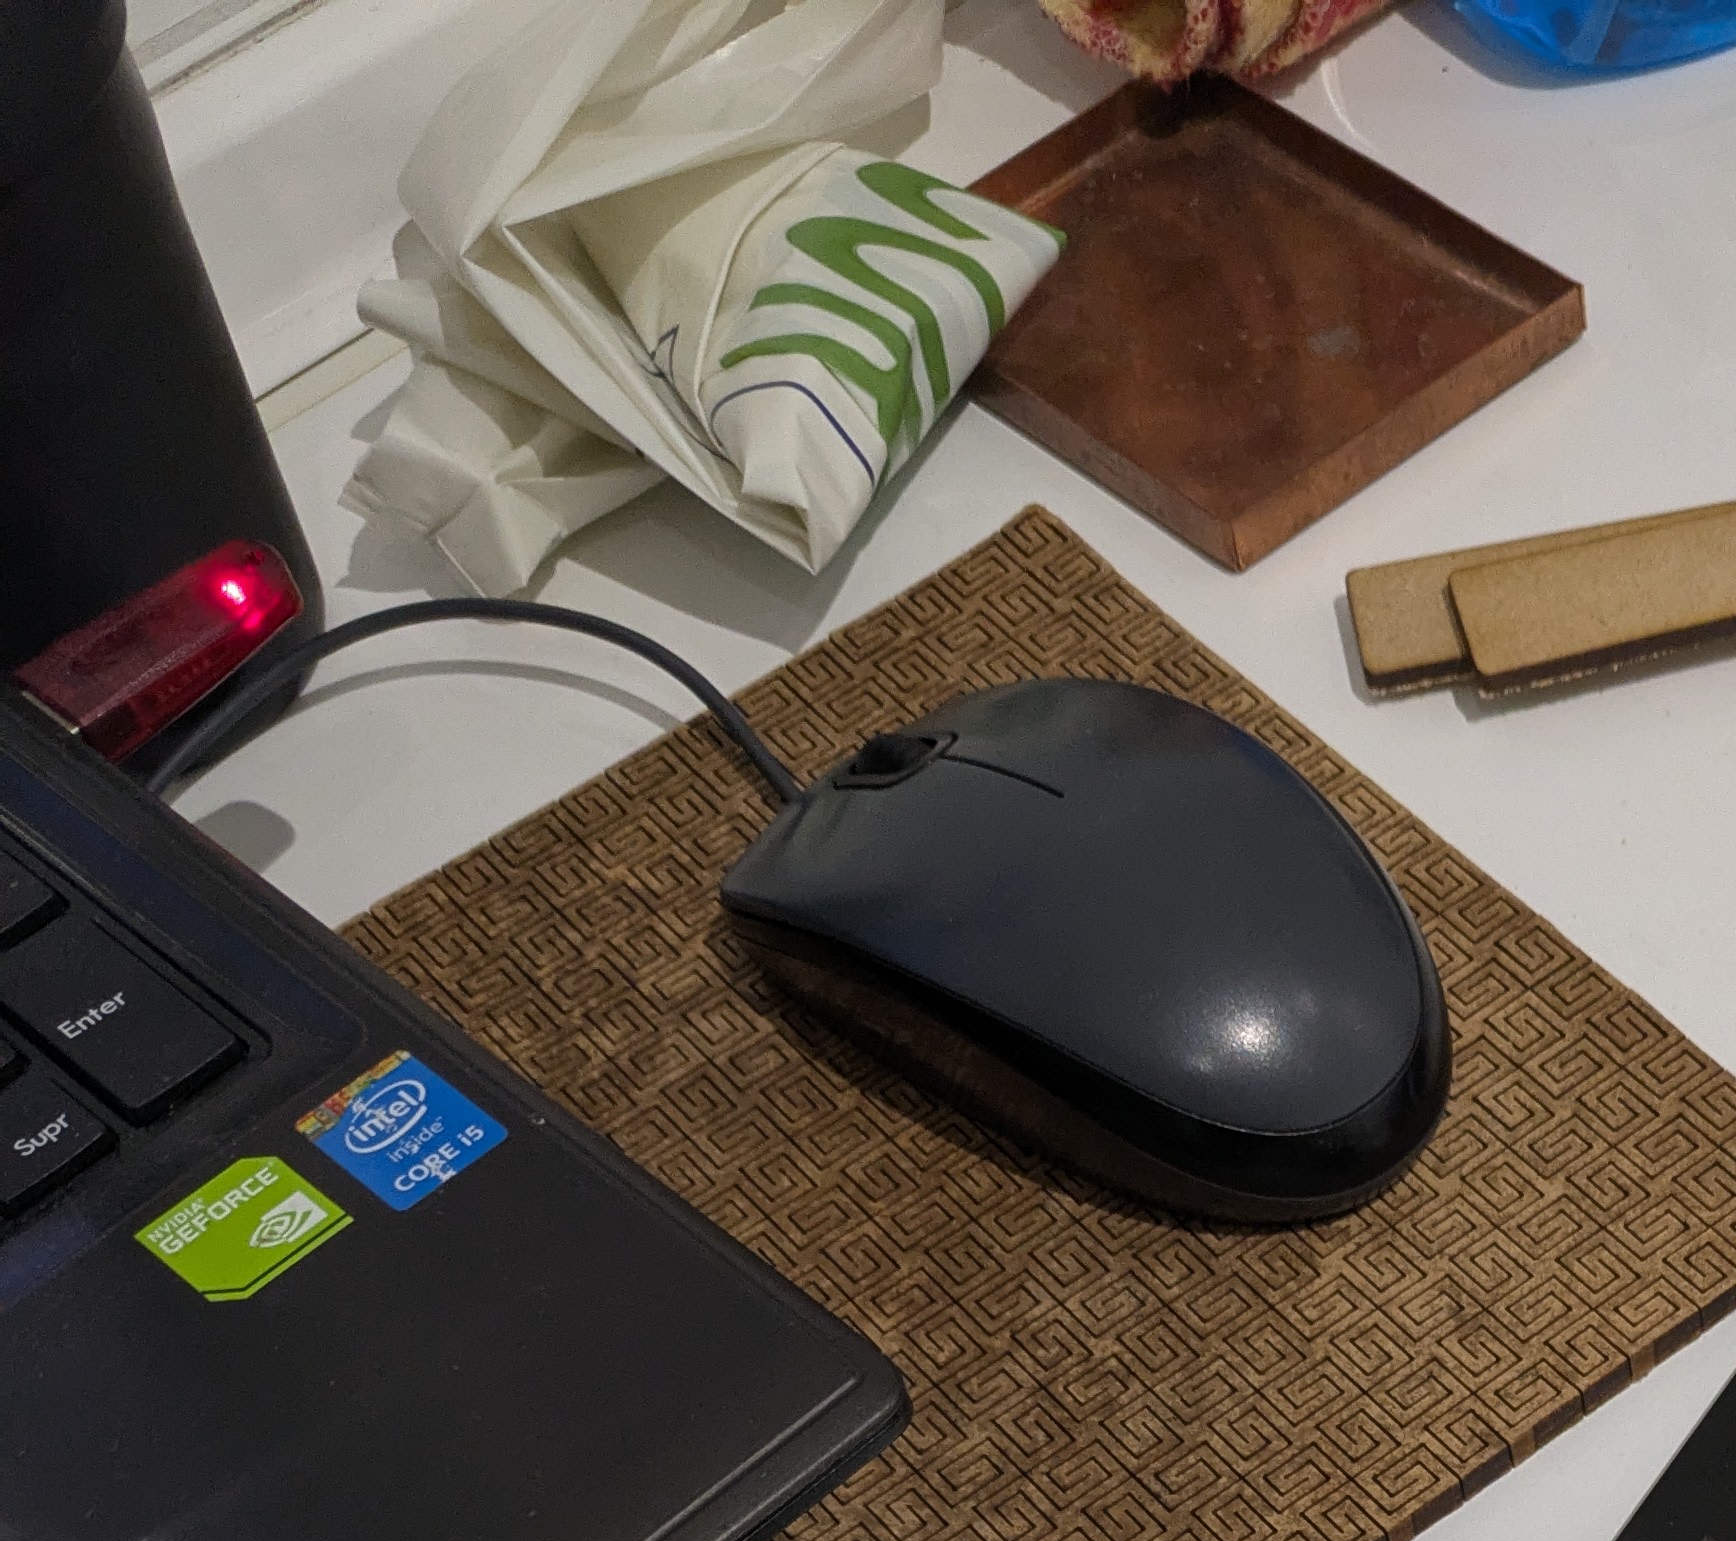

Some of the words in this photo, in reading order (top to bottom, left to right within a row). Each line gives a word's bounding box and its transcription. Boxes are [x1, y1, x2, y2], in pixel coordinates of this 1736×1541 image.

[58, 990, 125, 1040] Enter
[13, 1112, 70, 1157] Supr
[349, 1090, 419, 1142] intel
[394, 1141, 461, 1191] CORE
[456, 1124, 484, 1148] i5
[158, 1167, 279, 1255] GEFORCE
